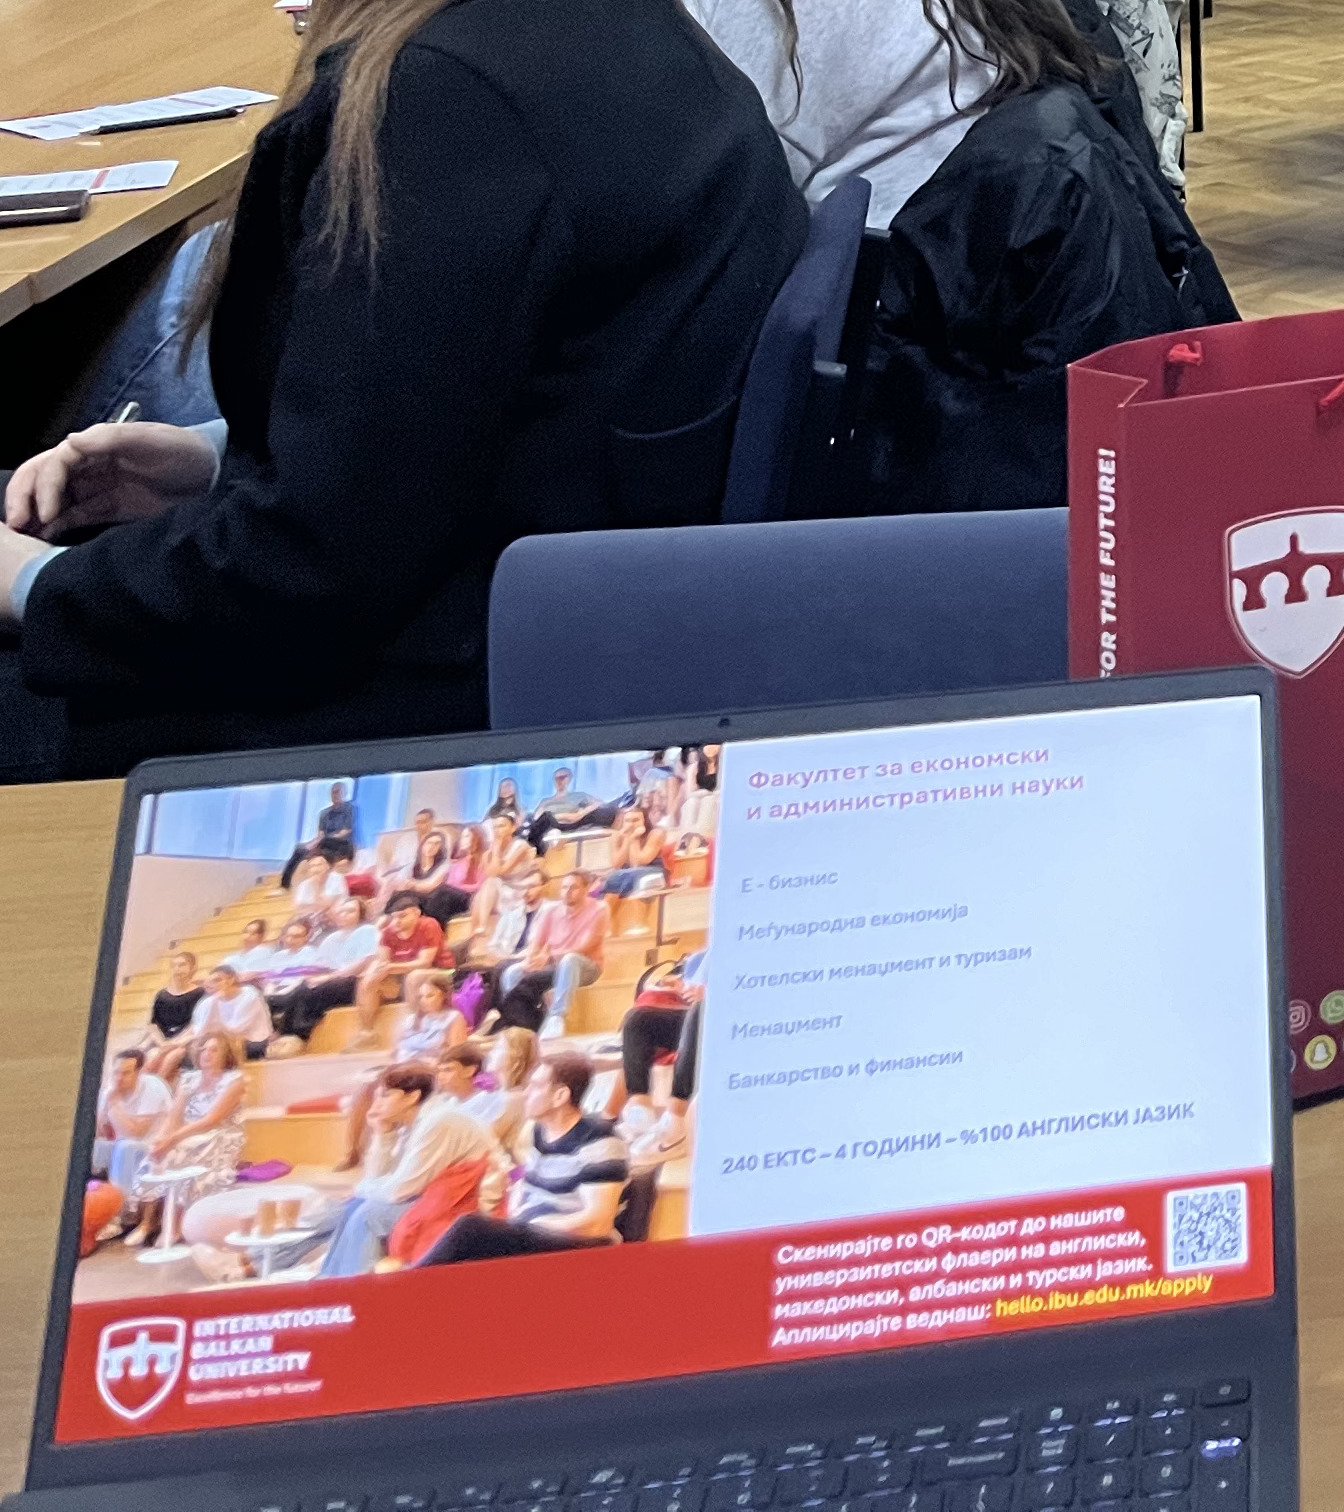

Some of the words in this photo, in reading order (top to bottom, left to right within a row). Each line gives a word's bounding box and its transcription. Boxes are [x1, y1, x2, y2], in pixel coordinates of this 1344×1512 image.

[1098, 448, 1117, 565] FUTURE!
[1099, 572, 1117, 625] THE
[748, 765, 869, 790] Факултет
[875, 760, 903, 778] за
[911, 747, 1050, 774] економски
[746, 806, 762, 821] и
[769, 781, 1004, 820] административни
[1011, 773, 1085, 798] науки
[741, 878, 753, 893] Е
[769, 871, 839, 890] бизнис
[738, 915, 866, 941] Меѓународна
[870, 903, 969, 927] економија
[733, 967, 824, 991] Хотелски
[828, 955, 936, 981] менаџмент
[939, 955, 951, 968] и
[955, 945, 1032, 969] туризам
[731, 1014, 843, 1040] Менаџмент
[728, 1062, 844, 1091] Банкарство
[848, 1062, 860, 1076] и
[864, 1050, 964, 1078] финансии
[721, 1153, 759, 1175] 240
[763, 1147, 817, 1171] ЕКТС
[834, 1143, 849, 1161] 4
[852, 1131, 942, 1160] ГОДИНИ
[960, 1123, 1014, 1146] %100
[1016, 1108, 1129, 1139] АНГЛИСКИ
[1133, 1101, 1195, 1127] ЈАЗИК
[777, 1233, 893, 1265] Скенирајте
[897, 1233, 918, 1250] го
[921, 1219, 1019, 1249] QR-кодот
[1020, 1215, 1046, 1237] до
[1050, 1206, 1126, 1230] нашите
[775, 1256, 937, 1295] универзитетски
[941, 1244, 1017, 1274] флаери
[1021, 1244, 1046, 1259] на
[1049, 1229, 1146, 1257] англиски,
[772, 1313, 902, 1348] Аплицирајте
[906, 1304, 992, 1330] веднаш:
[996, 1274, 1214, 1317] hello.ibu.edu.mk/apply
[774, 1289, 905, 1321] македонски,
[909, 1274, 1005, 1303] албански
[1009, 1273, 1022, 1288] и
[1027, 1261, 1092, 1289] турски
[1096, 1255, 1153, 1280] јазик.
[193, 1304, 356, 1338] INTERNATIONAL
[189, 1352, 311, 1381] UNIVERSITY
[191, 1335, 274, 1360] BALKAN
